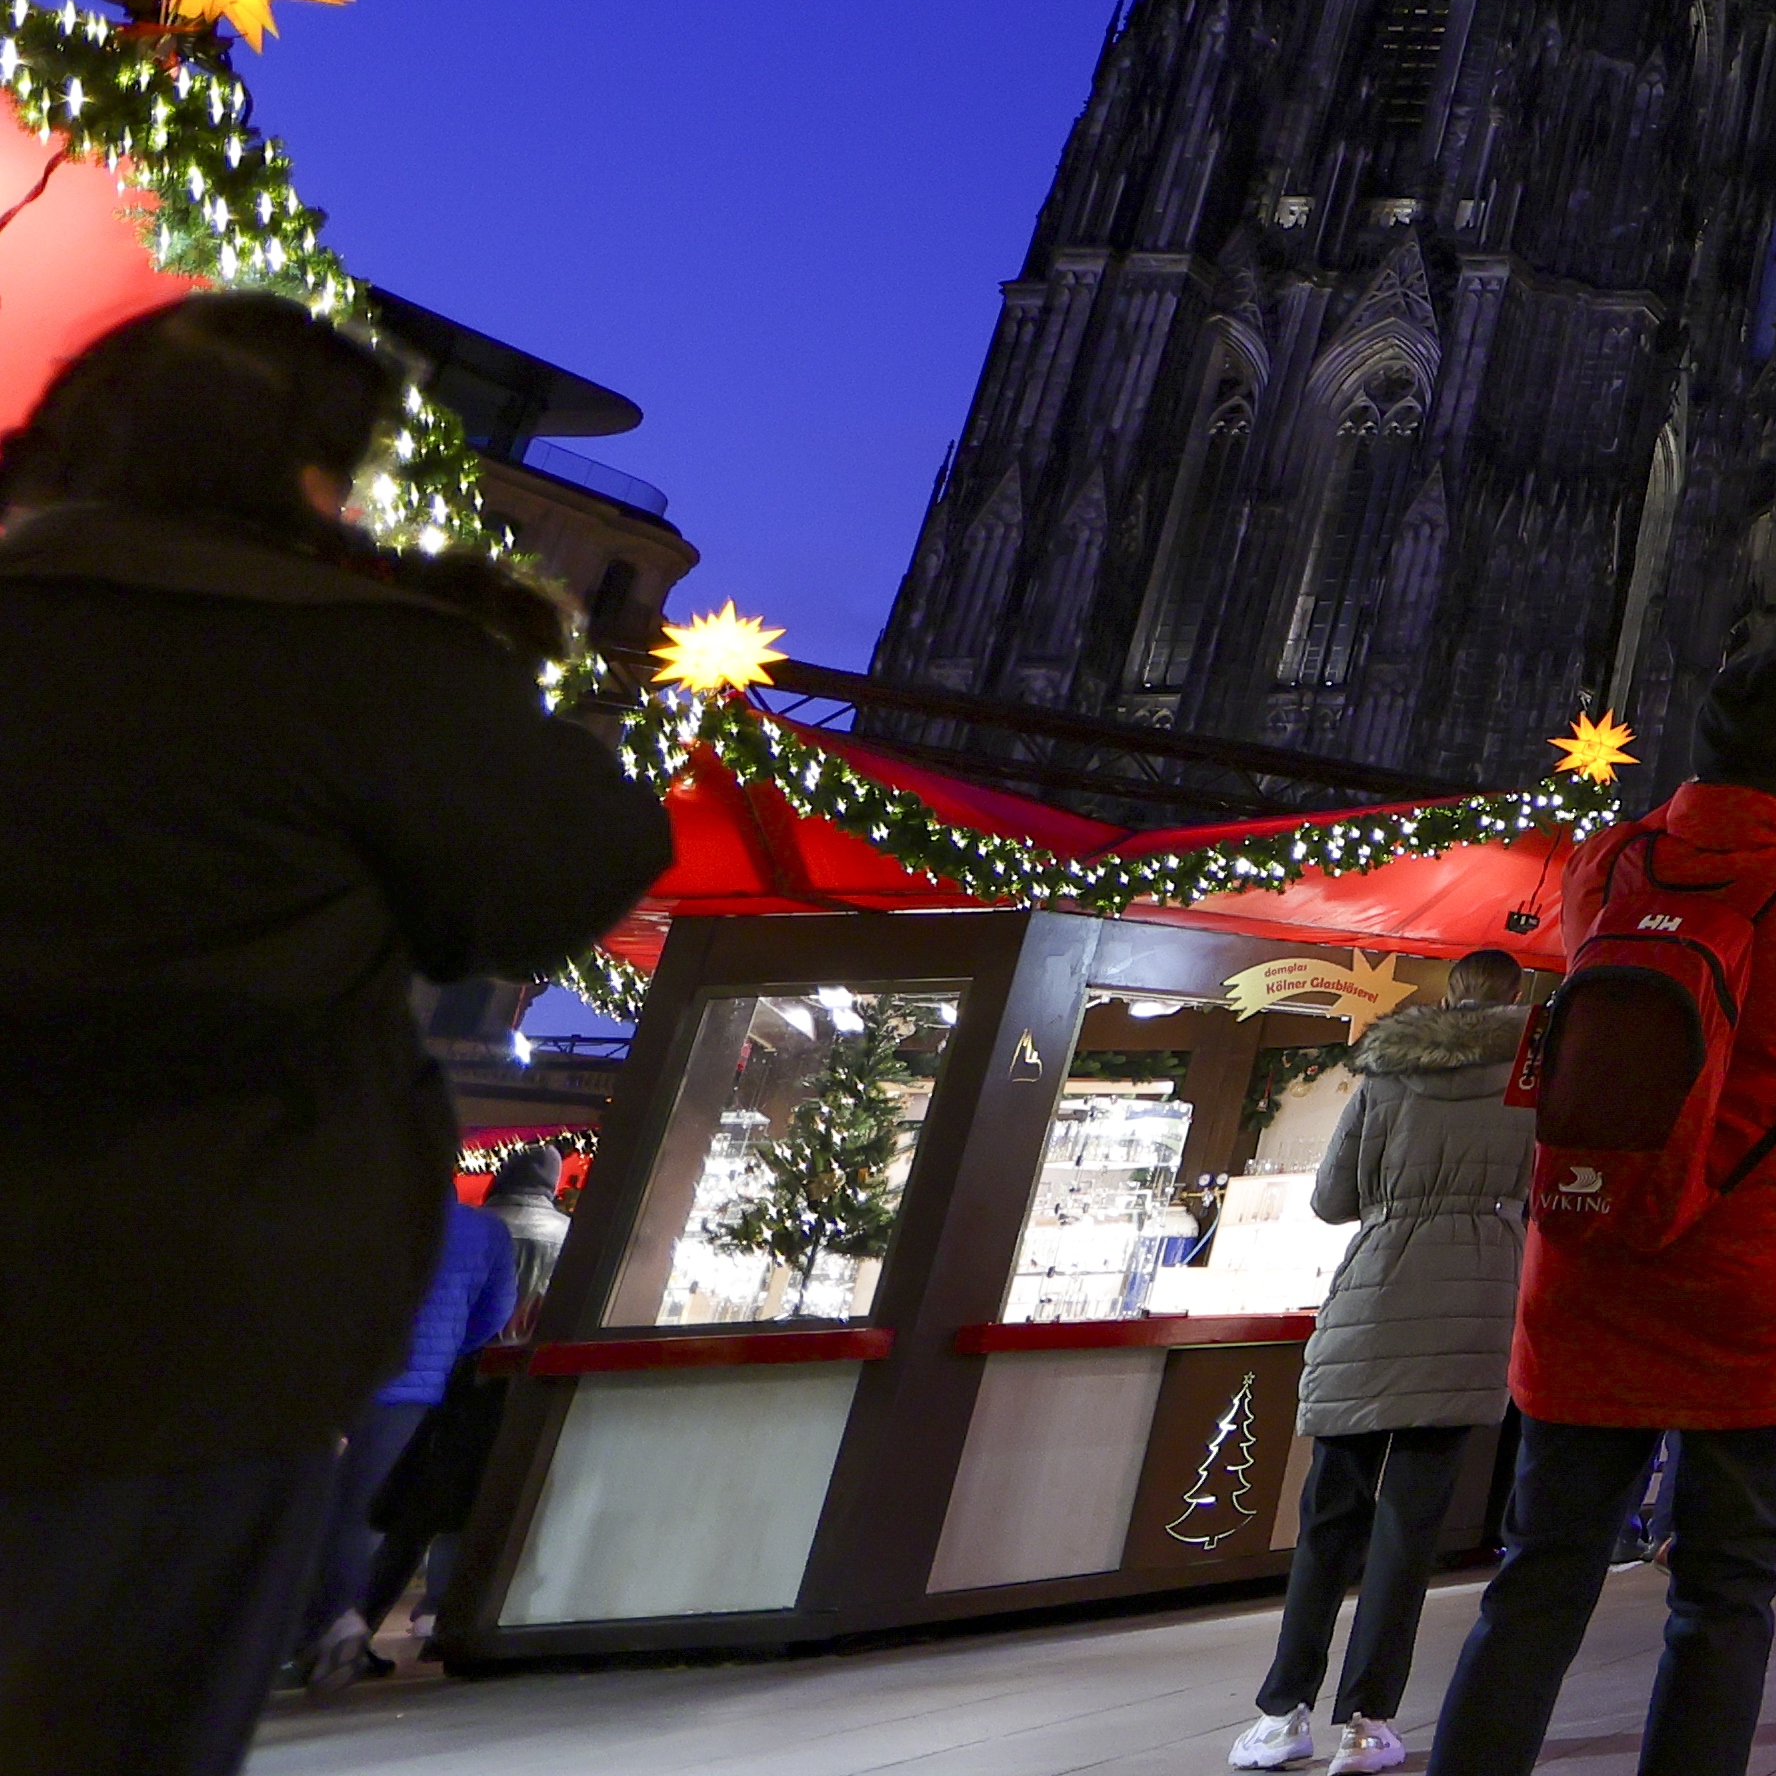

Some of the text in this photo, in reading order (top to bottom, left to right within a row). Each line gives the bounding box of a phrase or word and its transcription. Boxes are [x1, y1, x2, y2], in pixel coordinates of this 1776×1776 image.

[1637, 914, 1683, 931] HH
[1264, 962, 1307, 977] domglas
[1266, 979, 1308, 995] Kölner
[1540, 1194, 1612, 1214] VIKING
